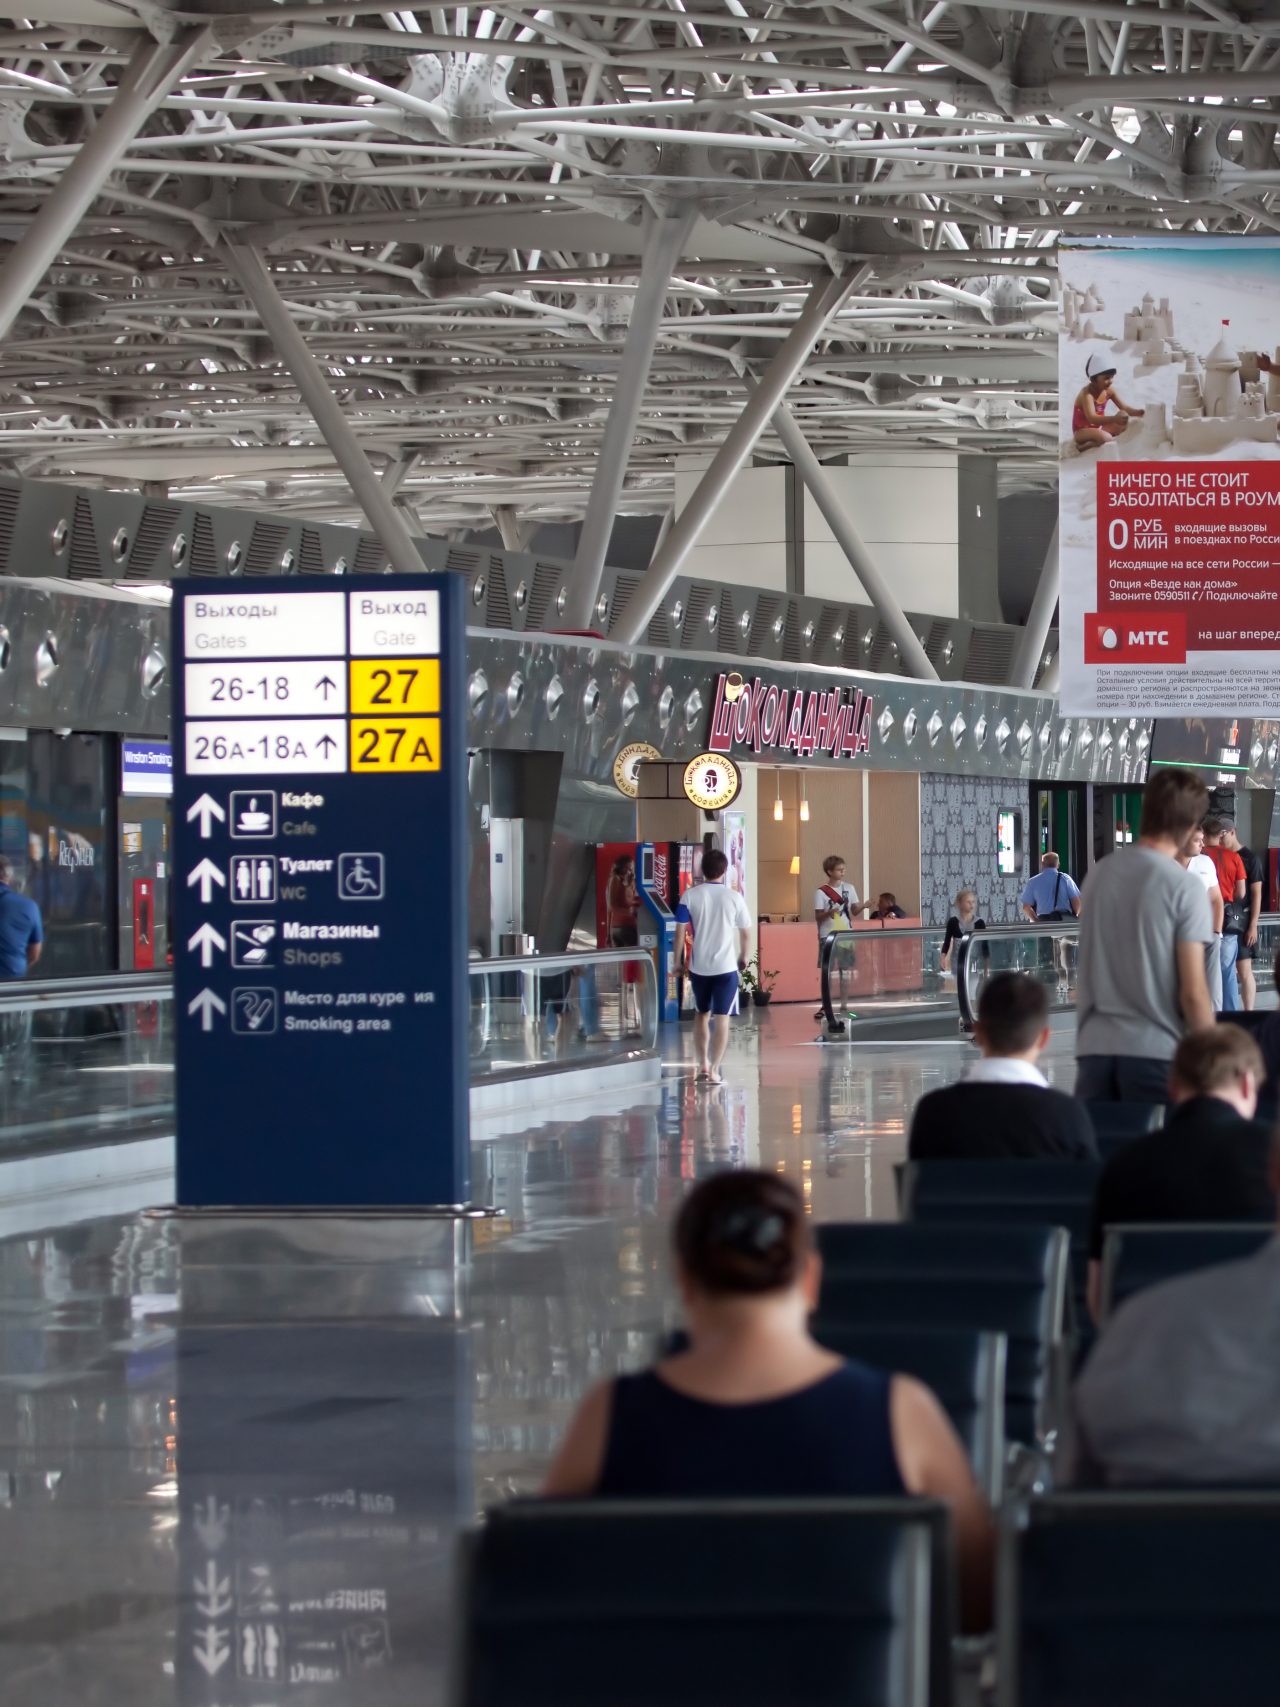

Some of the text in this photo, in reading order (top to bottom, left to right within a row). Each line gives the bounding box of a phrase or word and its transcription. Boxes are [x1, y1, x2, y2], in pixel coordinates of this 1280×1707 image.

[1108, 472, 1249, 488] НИЧЕГО НЕ СТОИТ
[1108, 492, 1216, 507] ЗАБОЛТАТЬСЯ
[1220, 492, 1230, 506] В
[1133, 519, 1162, 532] РУБ
[1174, 524, 1267, 533] входящие вызовы
[1108, 518, 1129, 550] 0
[1174, 536, 1181, 544] в
[1183, 536, 1231, 545] поездках
[1234, 536, 1247, 544] по
[1133, 536, 1168, 549] МИН
[1109, 559, 1168, 571] Исходящие
[1171, 561, 1183, 569] на
[1186, 561, 1204, 569] все
[1206, 561, 1230, 569] сети
[1232, 558, 1269, 569] России
[1109, 579, 1238, 590] Опция «Везде как дома»
[1109, 591, 1151, 601] Звоните
[1154, 591, 1190, 601] 0590511
[1206, 590, 1278, 602] Подключайте
[195, 602, 278, 618] Выходы
[361, 600, 427, 617] Выход
[195, 633, 247, 650] Gates
[374, 630, 416, 646] Gate
[1128, 630, 1168, 646] МТС
[1198, 631, 1212, 640] на
[1215, 631, 1237, 640] шаг
[210, 676, 290, 702] 26-18
[370, 669, 419, 705] 27
[282, 791, 324, 809] Кафе
[282, 821, 317, 836] Cafe
[279, 857, 333, 875] Туалет
[280, 886, 307, 900] WC
[283, 922, 379, 939] Магазины
[283, 948, 342, 967] Shops
[284, 990, 333, 1005] Место
[335, 992, 367, 1006] для
[284, 1016, 391, 1034] Smoking area
